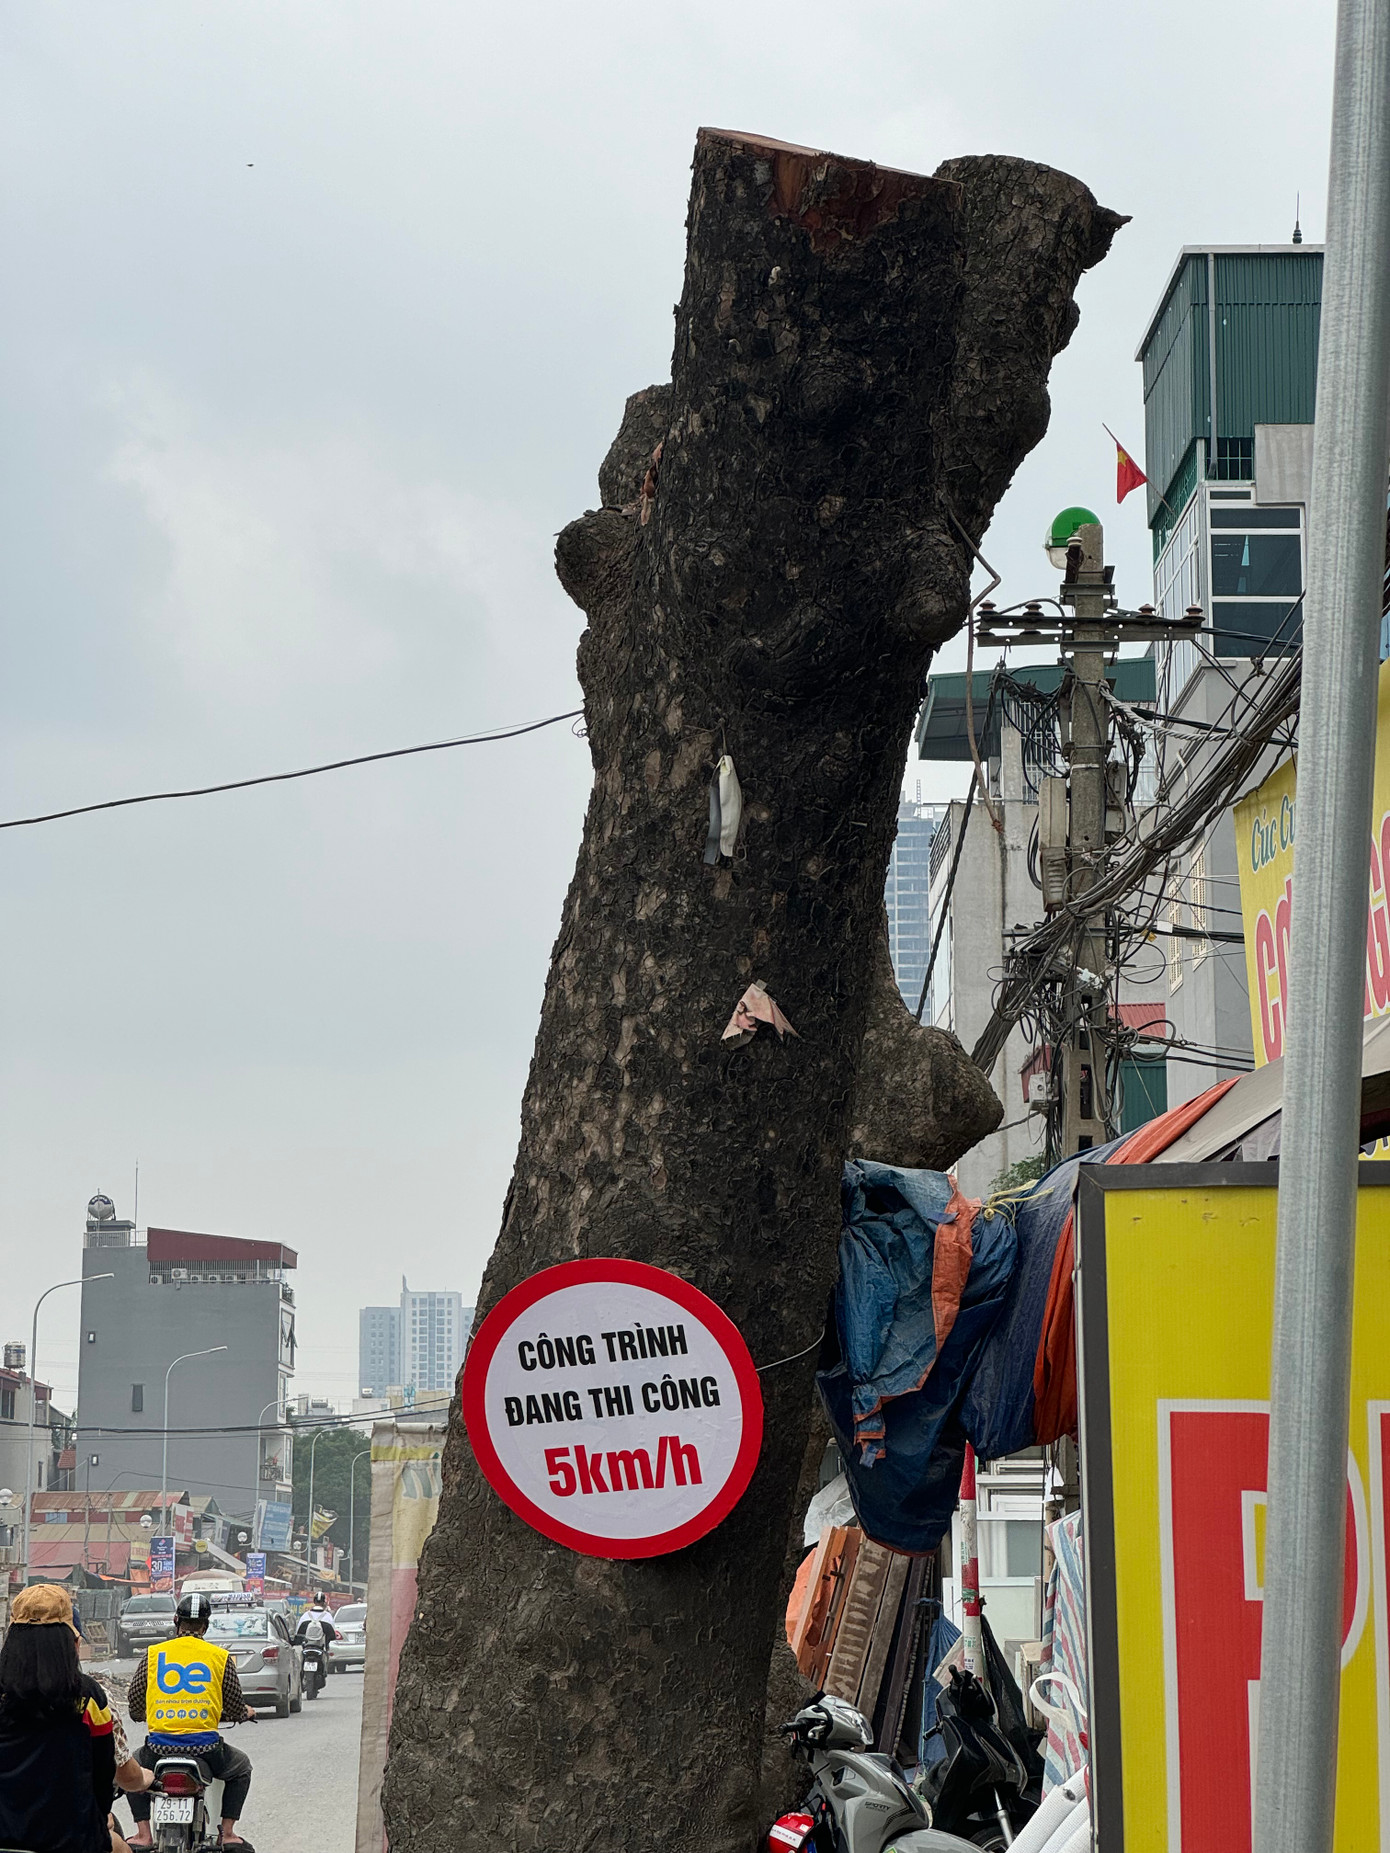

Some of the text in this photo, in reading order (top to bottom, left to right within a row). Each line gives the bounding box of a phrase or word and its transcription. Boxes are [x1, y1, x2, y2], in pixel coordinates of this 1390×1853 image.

[1251, 808, 1277, 872] Cúc
[518, 1322, 689, 1371] CÔNG TRÌNH
[504, 1373, 721, 1427] ĐANG THI CÔNG
[544, 1435, 703, 1498] 5km/h
[151, 1560, 163, 1572] 30
[157, 1652, 212, 1695] be
[157, 1810, 191, 1821] 256.72
[161, 1798, 188, 1809] 29-T1
